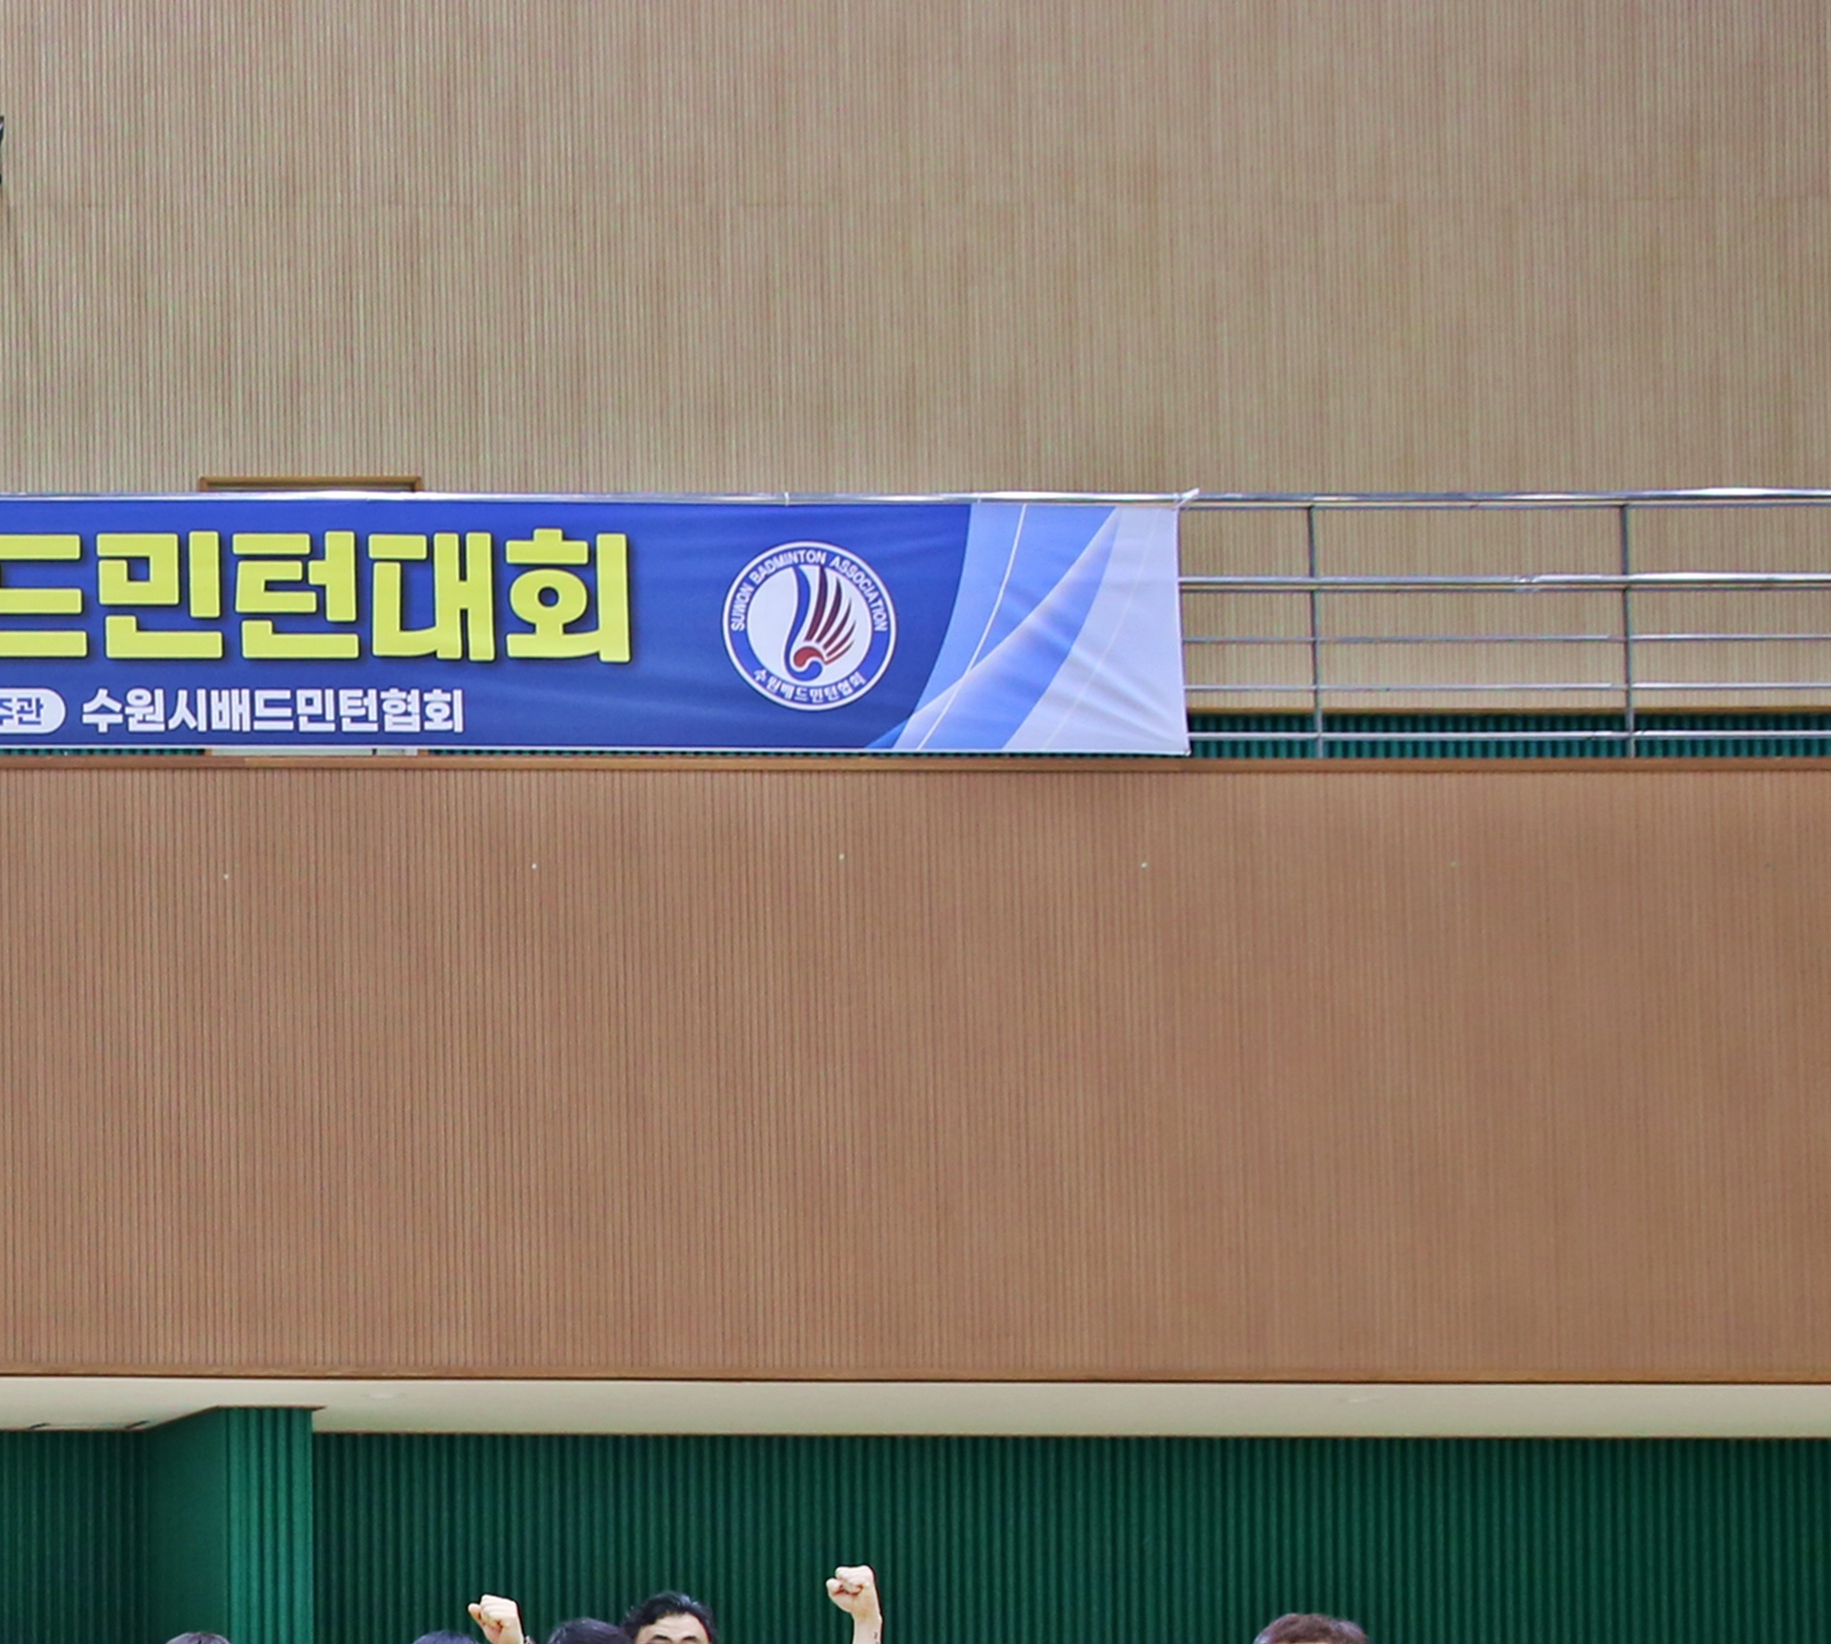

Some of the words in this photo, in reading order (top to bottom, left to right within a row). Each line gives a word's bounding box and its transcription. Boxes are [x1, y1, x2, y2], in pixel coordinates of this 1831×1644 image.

[731, 583, 754, 632] SUWON
[749, 549, 827, 585] BADMINTON
[830, 556, 888, 632] ASSOCIATION
[83, 689, 463, 732] 수원시배드민턴협회
